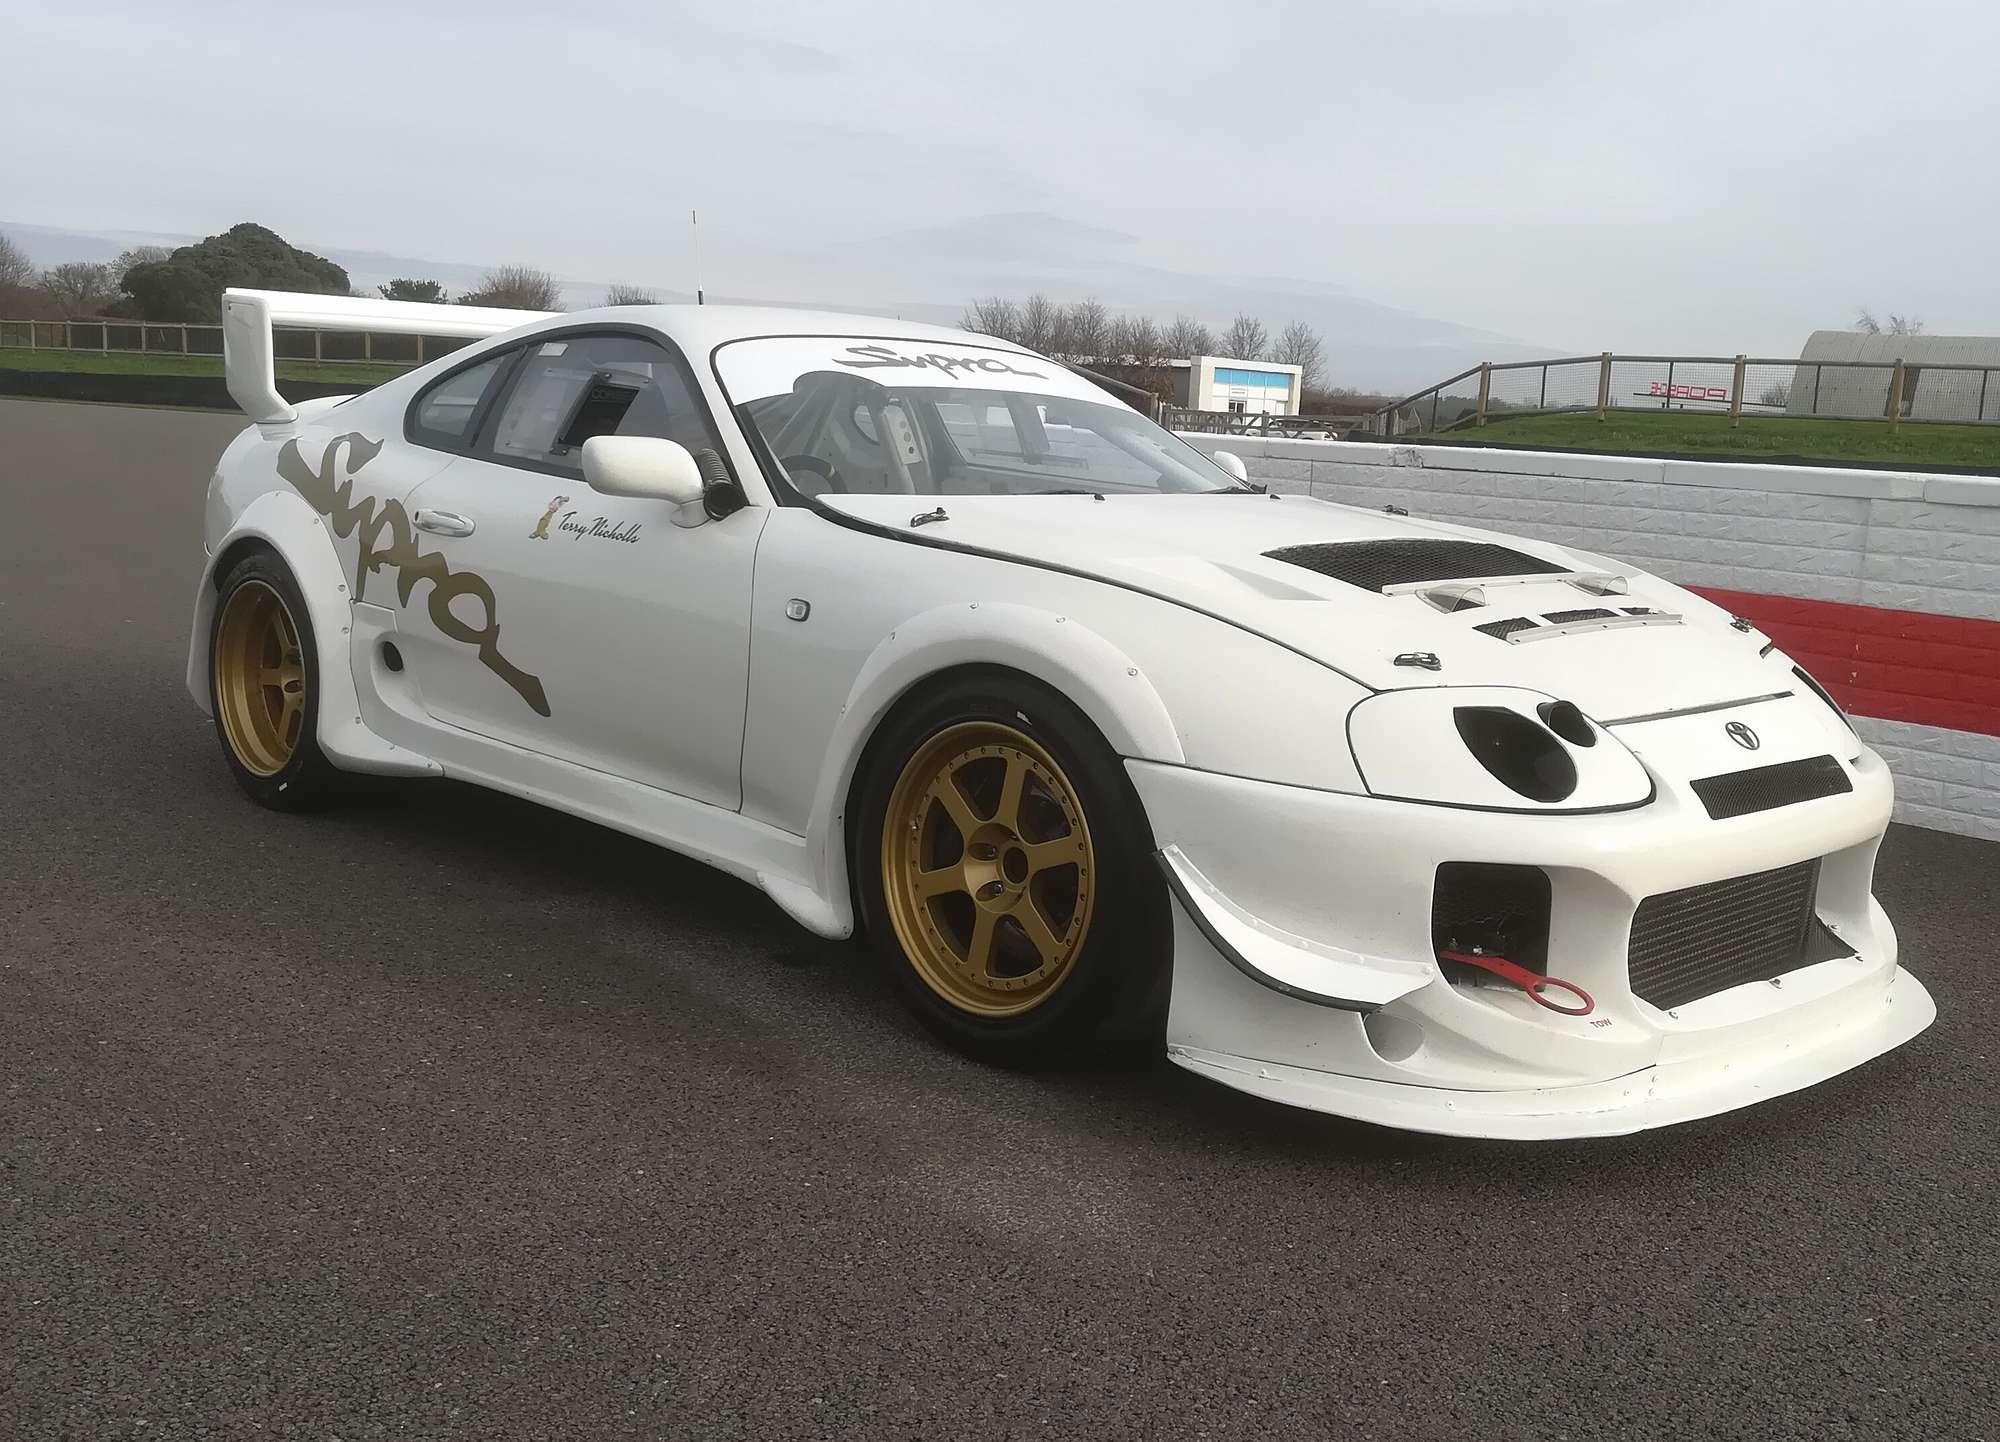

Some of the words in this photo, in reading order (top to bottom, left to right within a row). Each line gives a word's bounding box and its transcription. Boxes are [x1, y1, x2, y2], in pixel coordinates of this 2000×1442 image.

[832, 345, 1049, 380] Supra
[558, 511, 588, 541] Terry
[588, 516, 642, 544] Nicholls
[276, 431, 551, 717] Supra
[1589, 1018, 1612, 1029] TOW
